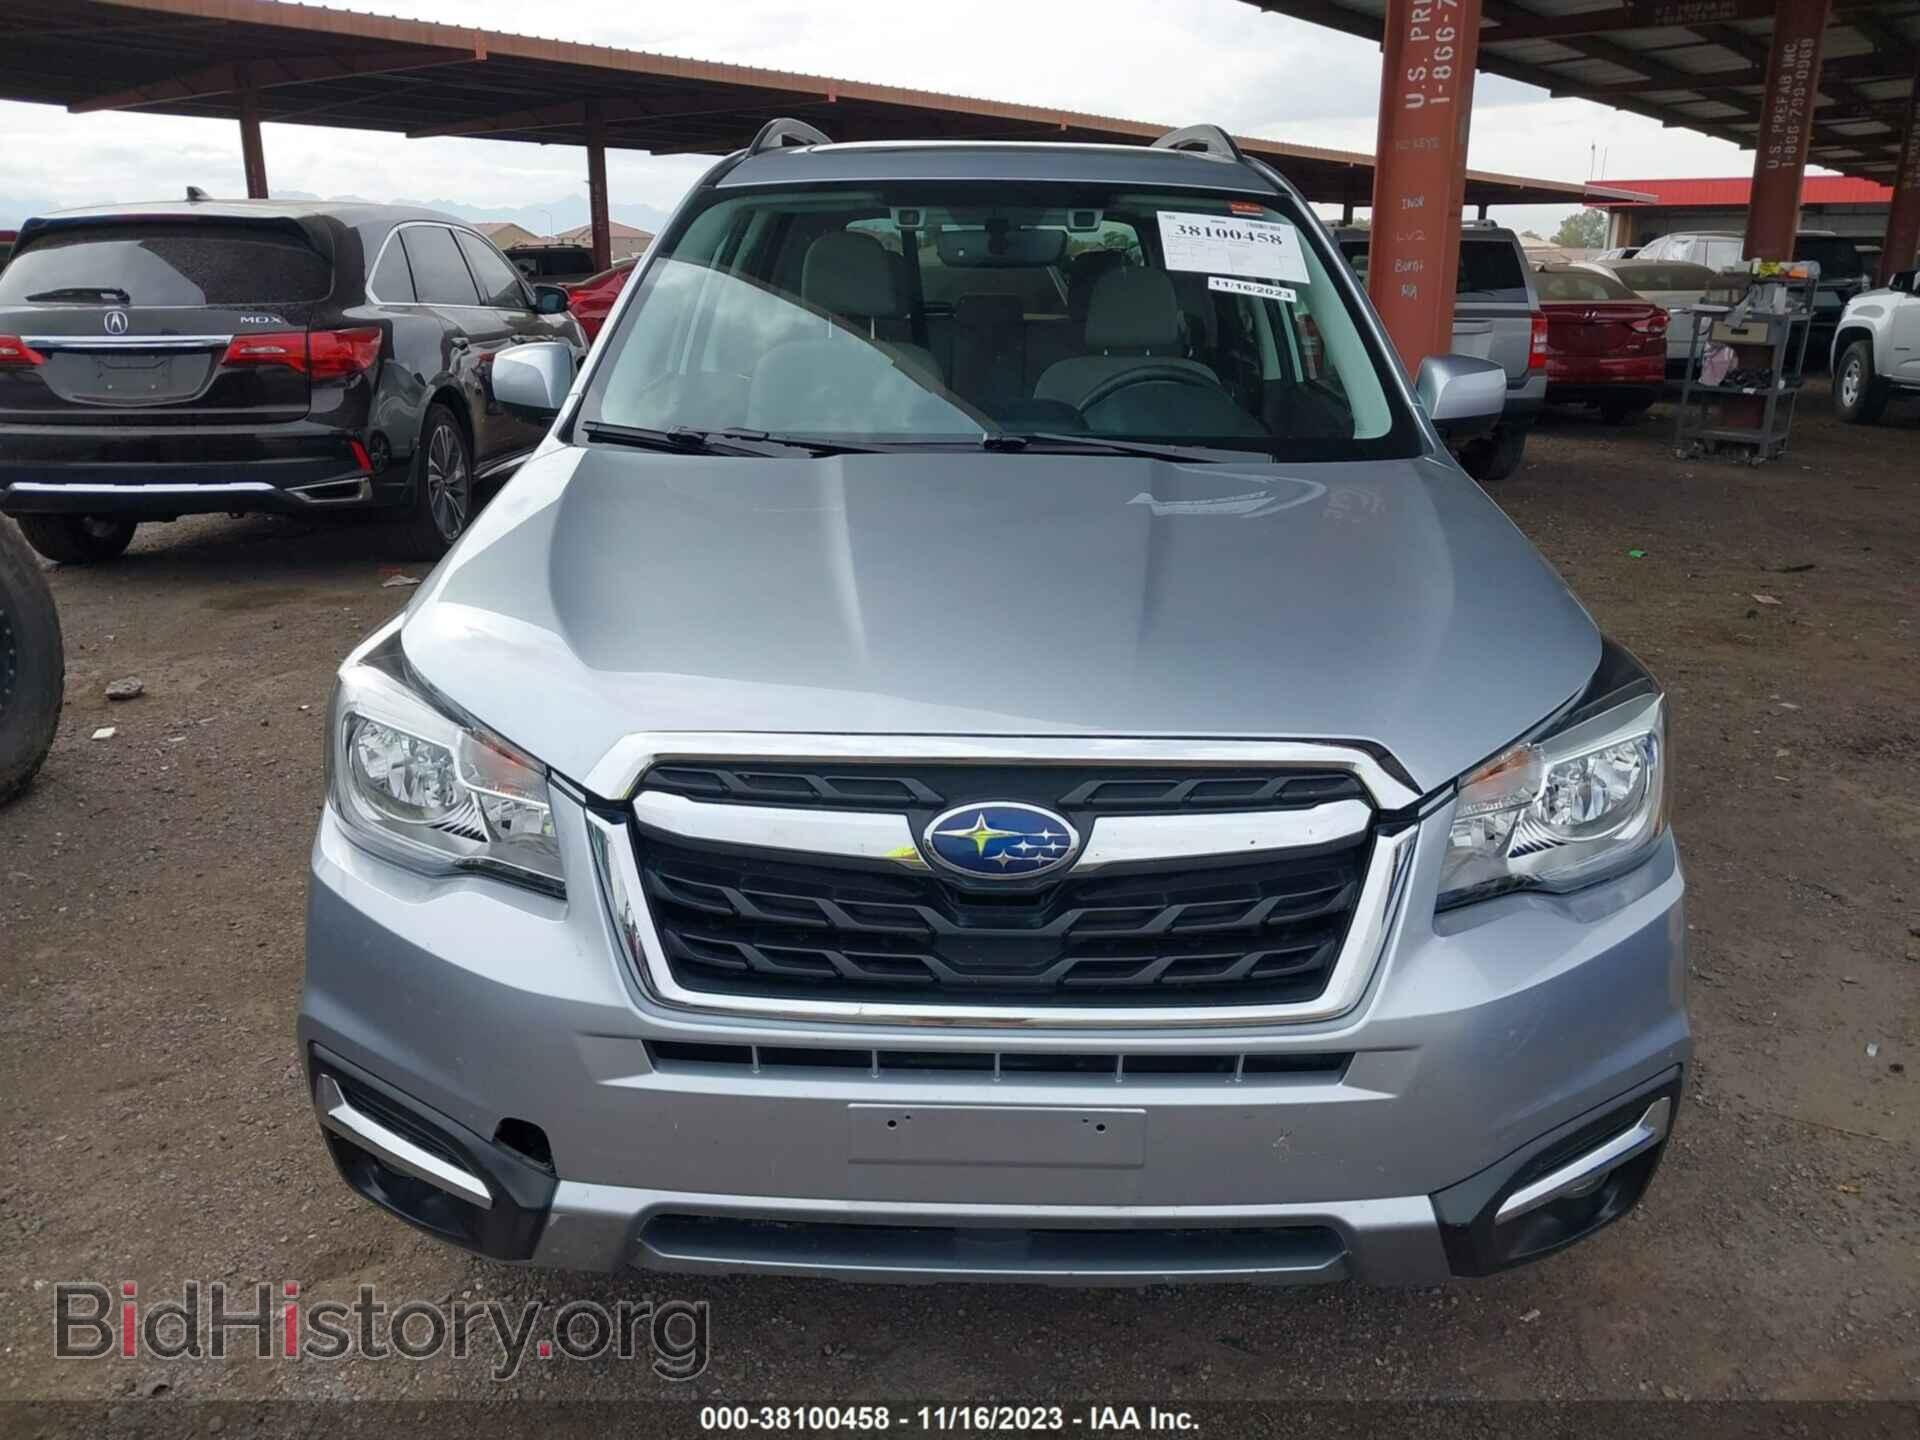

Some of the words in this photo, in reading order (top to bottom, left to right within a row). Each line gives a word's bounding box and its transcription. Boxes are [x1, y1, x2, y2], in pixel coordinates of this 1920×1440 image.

[1409, 0, 1432, 41] PR
[1405, 58, 1428, 109] U.S.
[1772, 74, 1792, 133] PREFAB
[1175, 224, 1283, 246] 38100458
[1212, 280, 1292, 299] 11/16/2023
[240, 316, 283, 324] MDX
